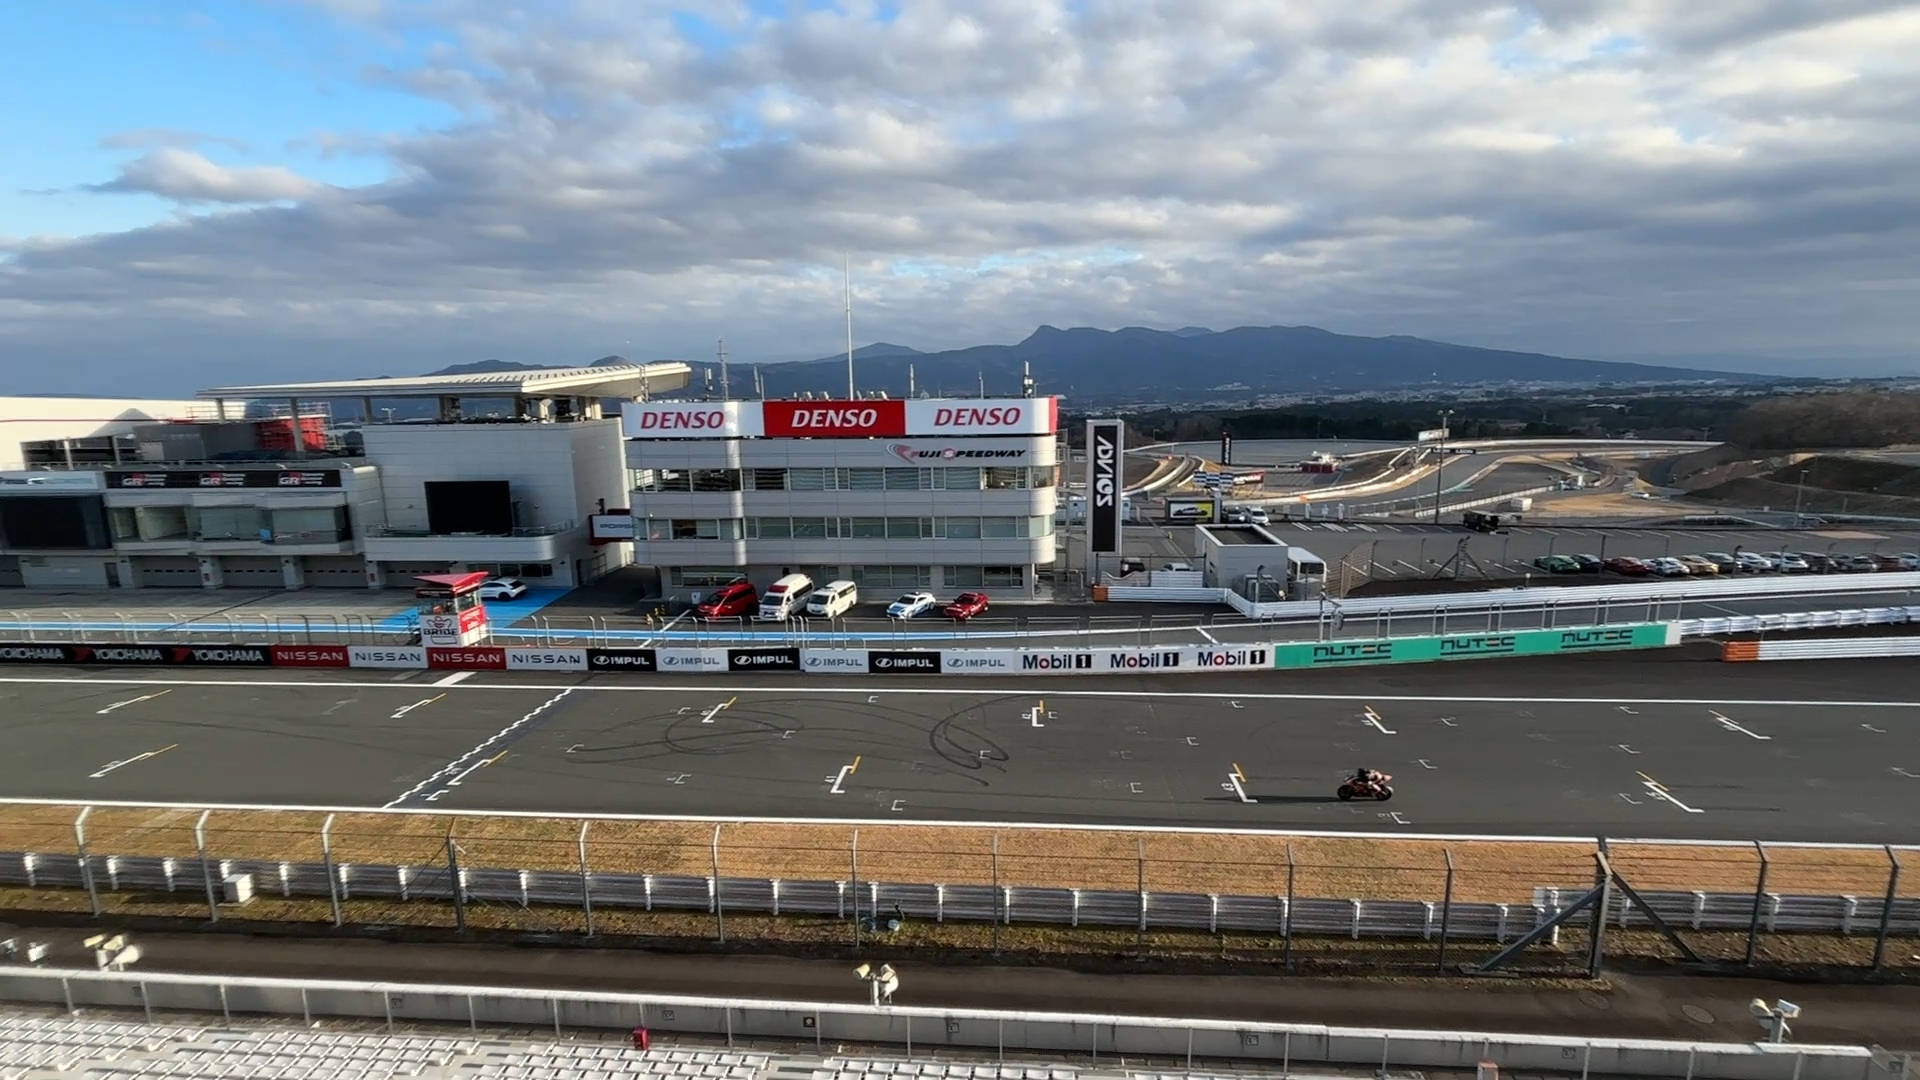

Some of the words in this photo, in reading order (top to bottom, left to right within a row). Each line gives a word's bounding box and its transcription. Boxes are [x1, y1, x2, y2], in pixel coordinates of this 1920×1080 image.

[640, 411, 724, 430] DENSO
[791, 408, 878, 428] DENSO
[933, 407, 1021, 427] DENSO
[942, 449, 1026, 459] SPEEDWAY
[92, 648, 164, 660] YOKOHAMA
[191, 649, 264, 661] YOKOHAMA
[277, 651, 344, 661] NISSAN
[355, 652, 421, 662] NISSAN
[433, 653, 500, 663] NISSAN
[512, 654, 581, 664] NISSAN
[1197, 651, 1246, 667] Mobil
[610, 656, 650, 665] IMPUL
[680, 656, 720, 665] IMPUL
[752, 655, 793, 664] IMPUL
[823, 657, 863, 667] IMPUL
[893, 658, 934, 668] IMPUL
[965, 658, 1006, 668] IMPUL
[1022, 654, 1072, 669] Mobil
[1110, 653, 1160, 668] Mobil
